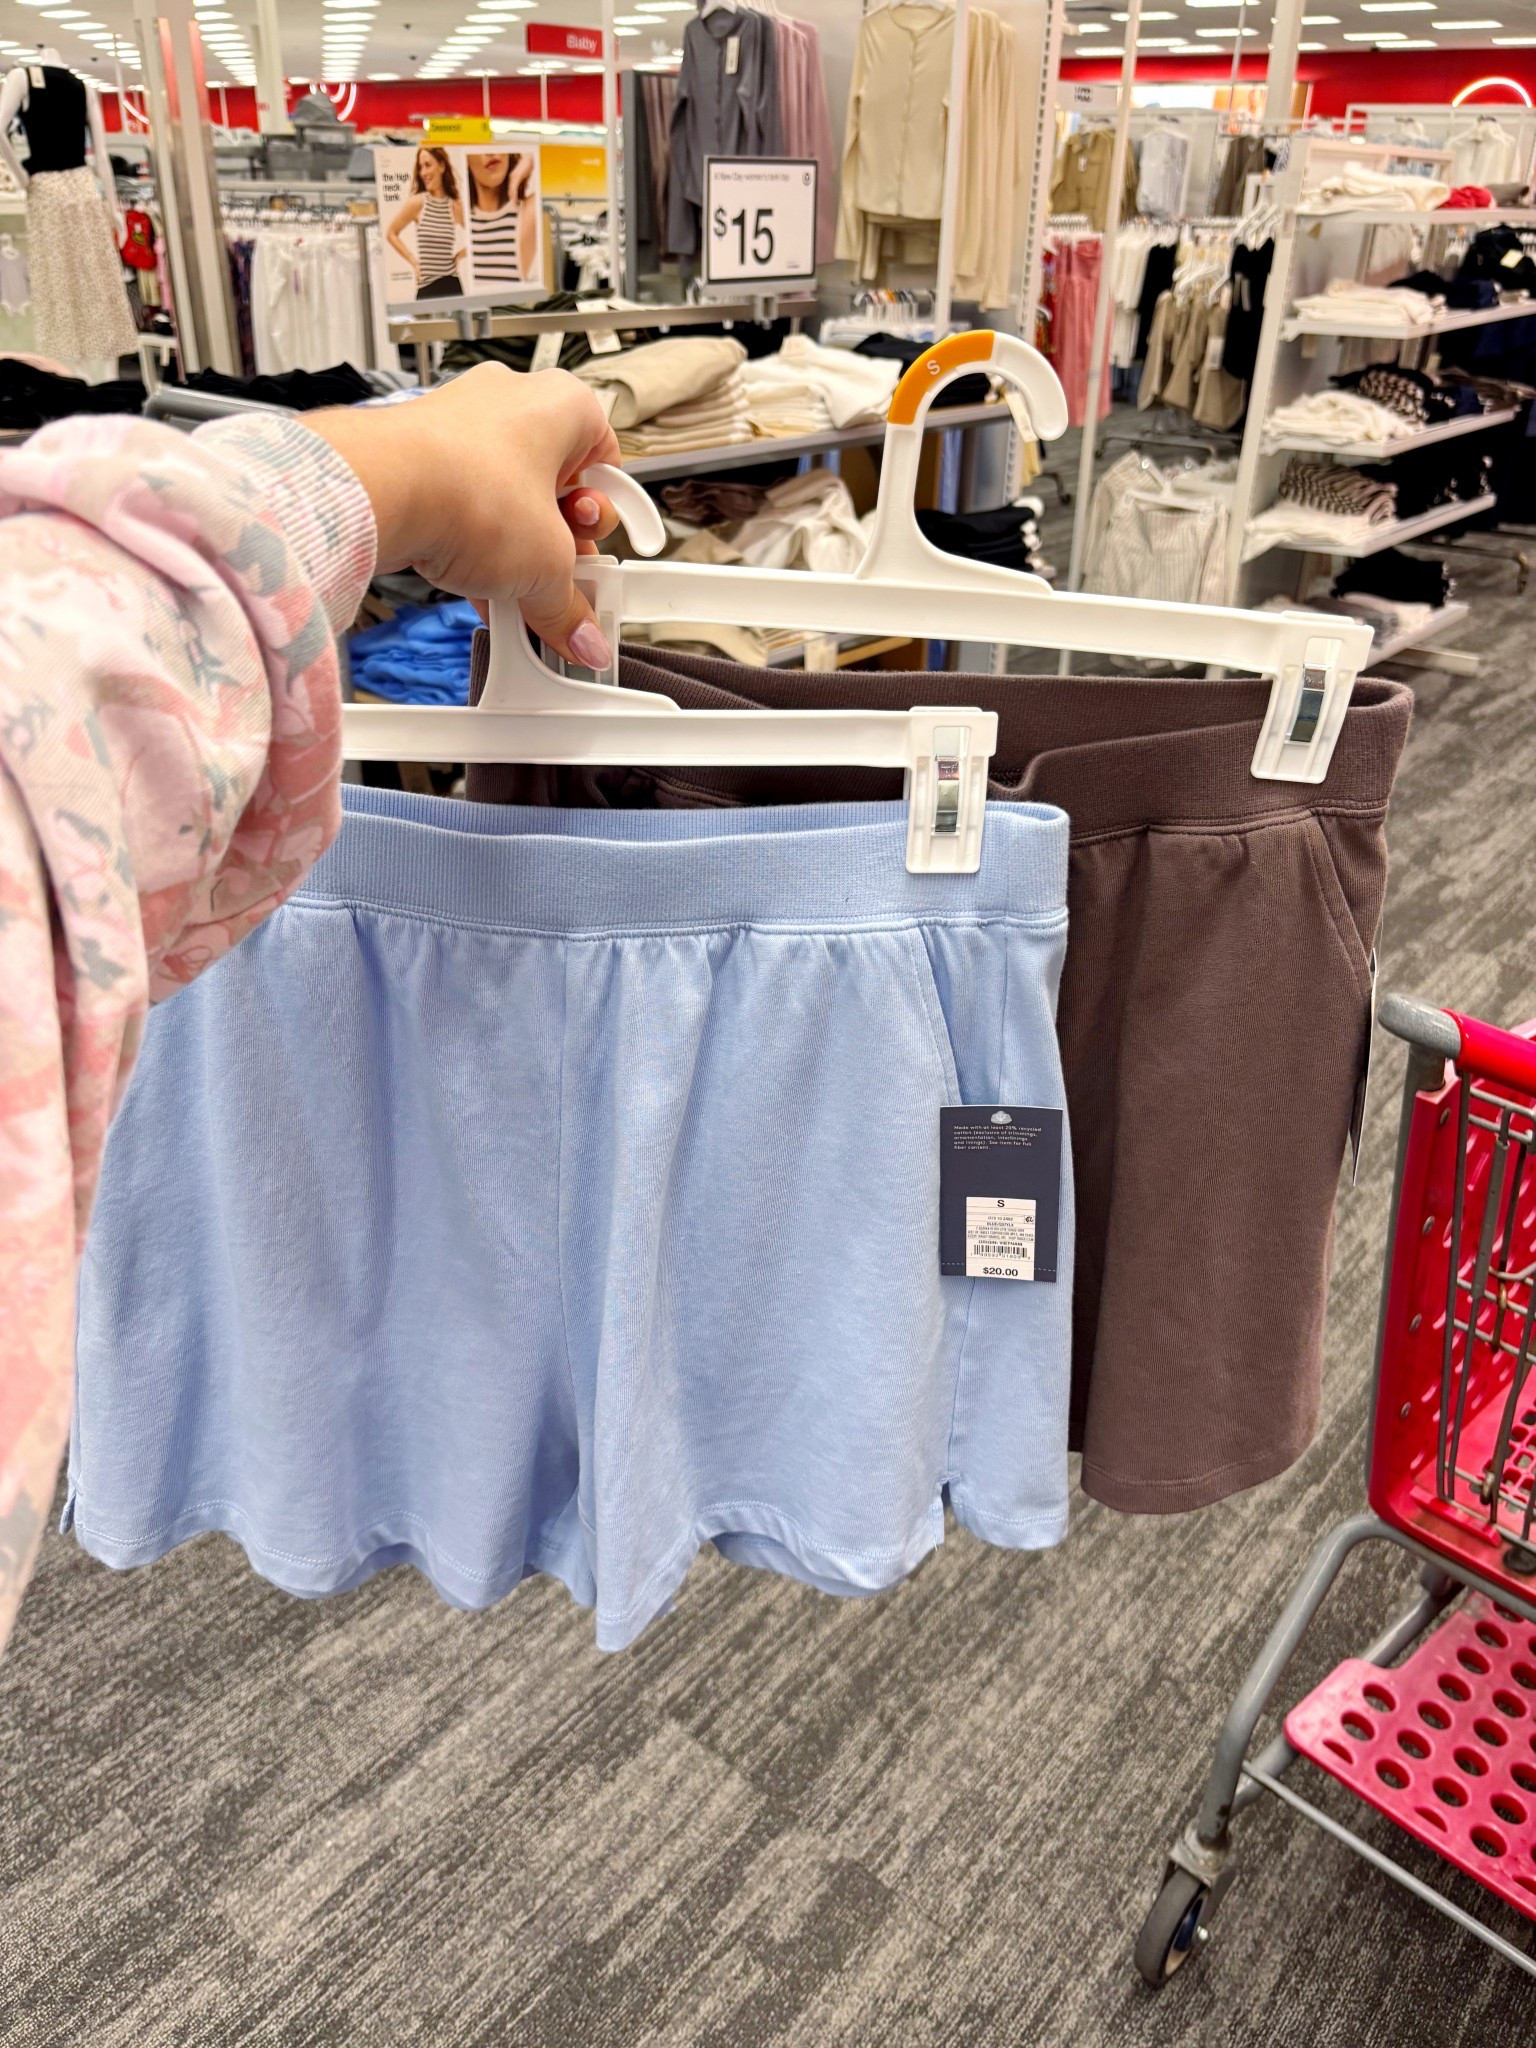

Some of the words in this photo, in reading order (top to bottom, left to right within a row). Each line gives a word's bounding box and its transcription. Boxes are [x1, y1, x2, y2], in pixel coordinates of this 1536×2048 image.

[566, 34, 598, 54] Baby
[926, 359, 941, 376] S
[997, 1199, 1005, 1208] S
[982, 1266, 1019, 1277] $20.00
